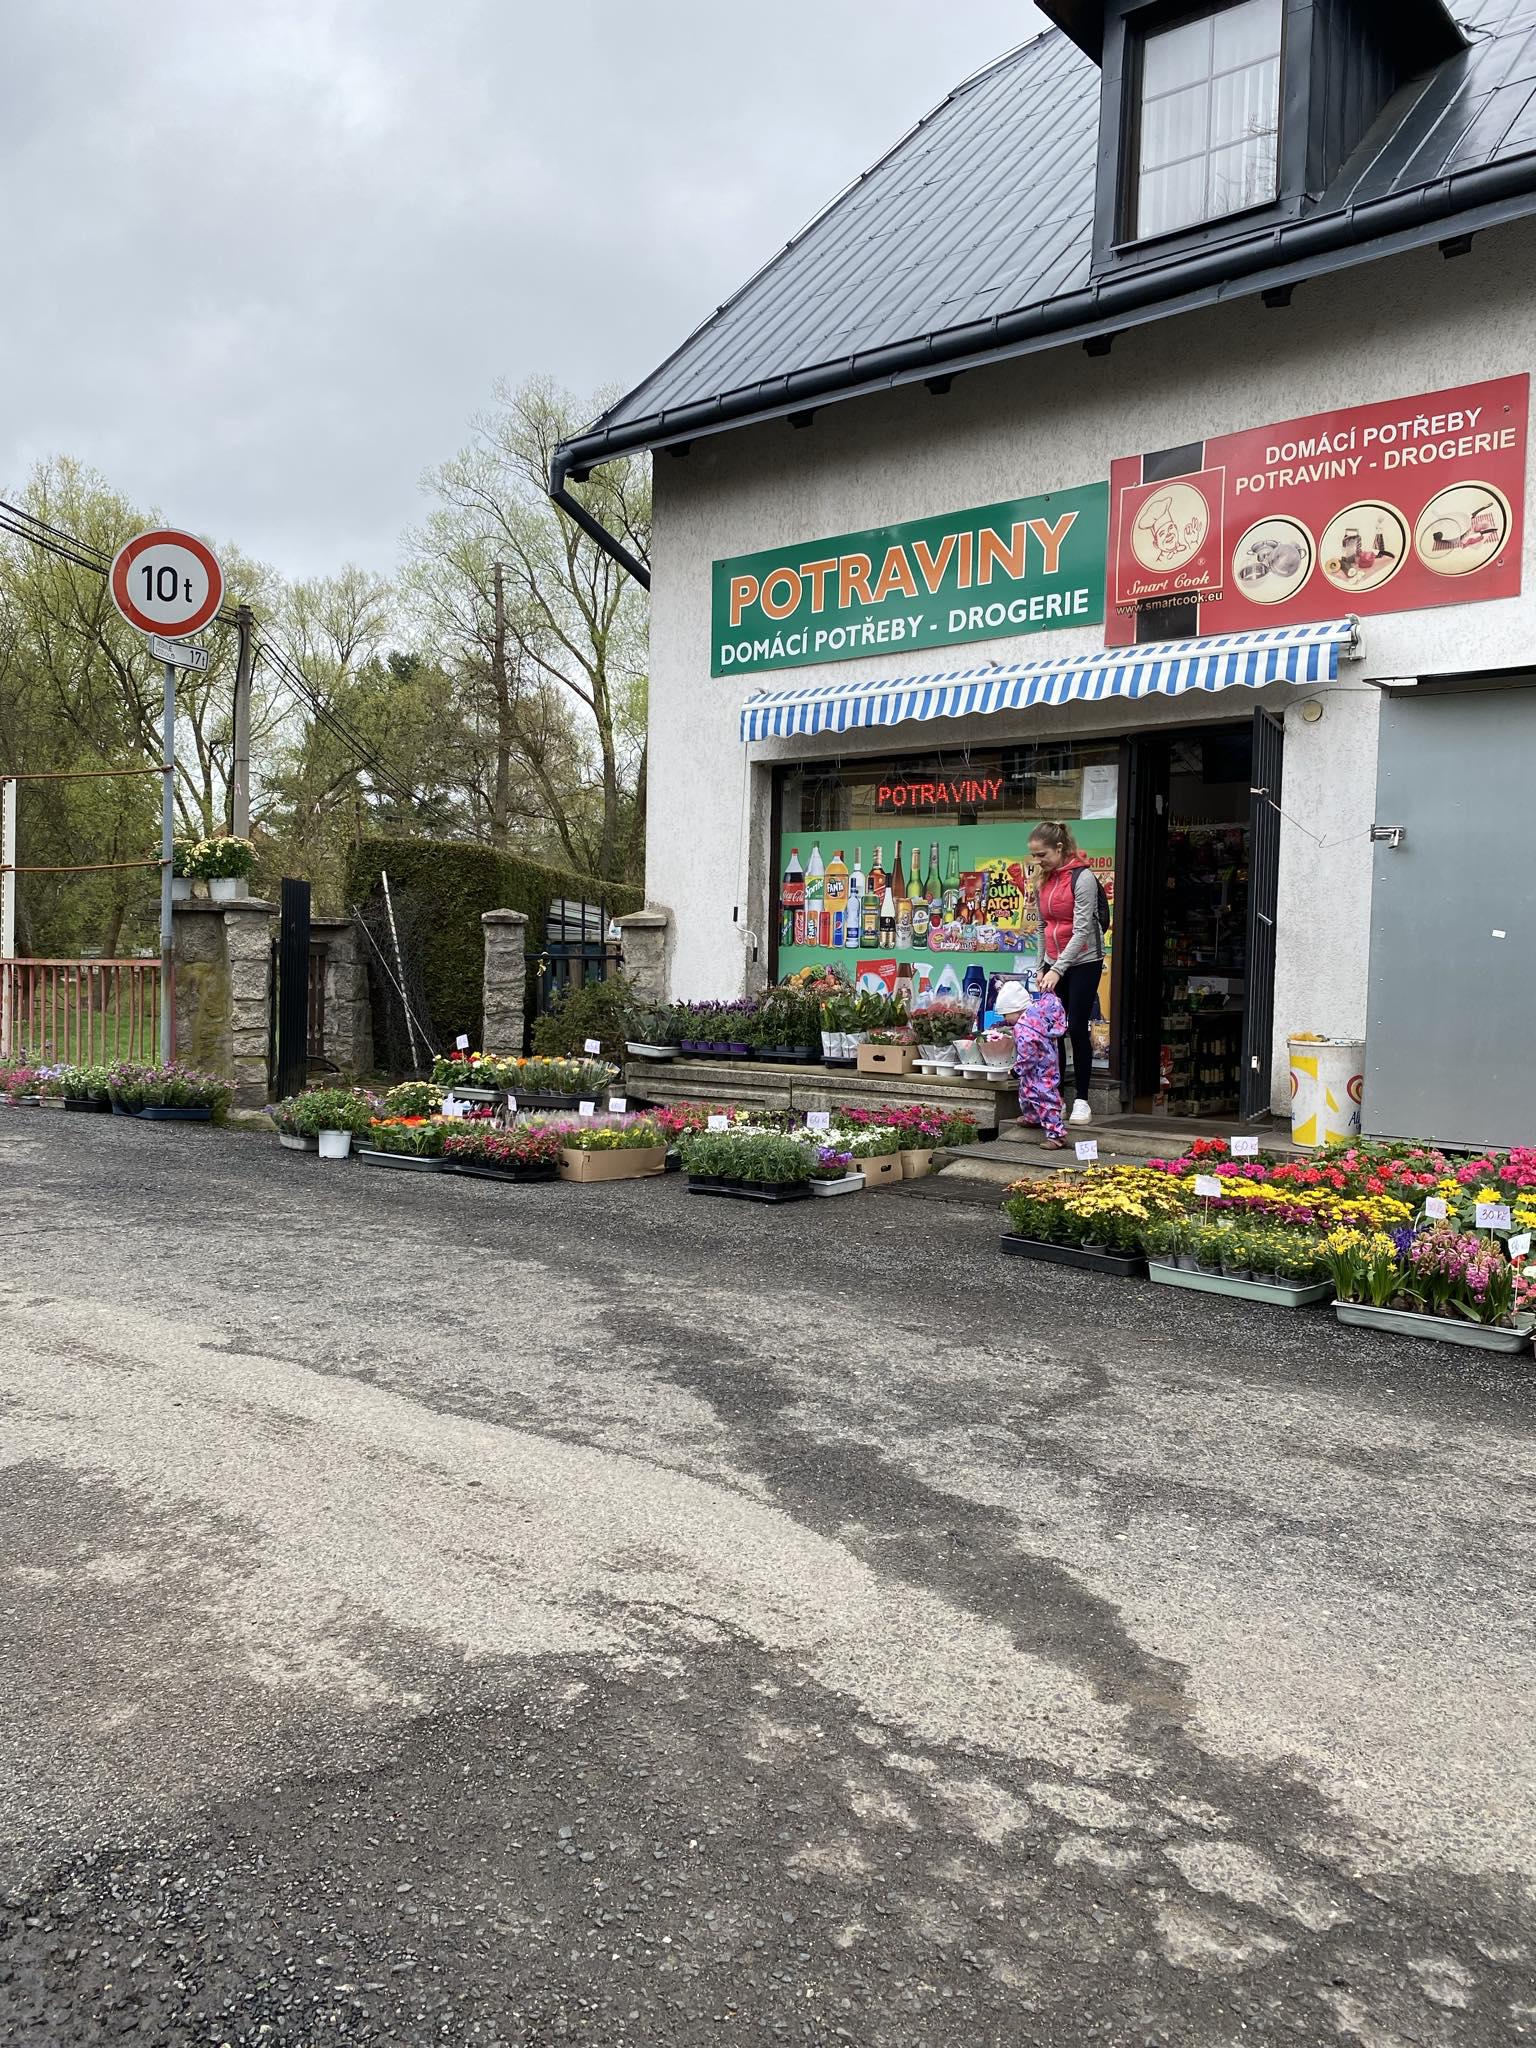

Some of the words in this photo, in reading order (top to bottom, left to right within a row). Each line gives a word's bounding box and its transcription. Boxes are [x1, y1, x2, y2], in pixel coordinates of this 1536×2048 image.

[1265, 426, 1356, 466] DOMÁCÍ
[1363, 407, 1483, 448] POTŘEBY
[1235, 456, 1363, 496] POTRAVINY
[1384, 427, 1516, 470] DROGERIE
[729, 510, 1080, 627] POTRAVINY
[1126, 579, 1169, 596] Smart
[1174, 570, 1210, 588] Cook
[1116, 591, 1223, 616] www.smartcook.eu
[721, 626, 808, 666] DOMÁCÍ
[814, 614, 924, 653] POTŘEBY
[948, 588, 1090, 634] DROGERIE
[878, 778, 1003, 807] POTRAVINY
[1479, 1209, 1495, 1220] 30
